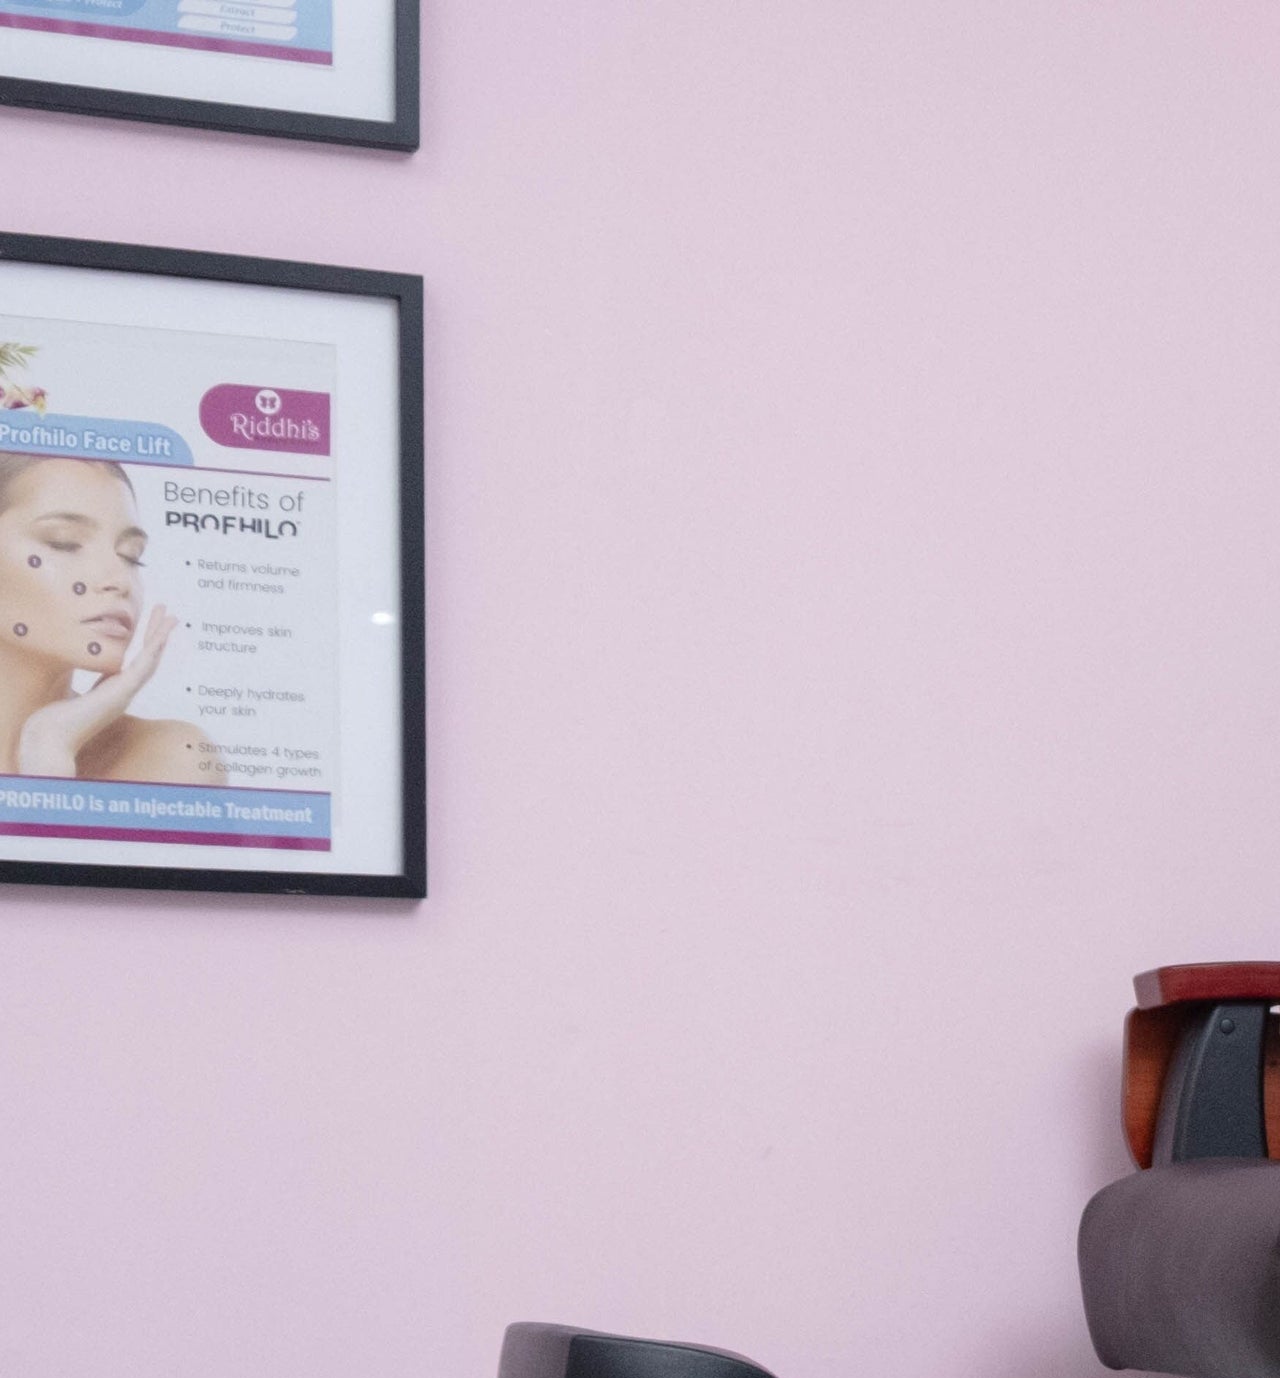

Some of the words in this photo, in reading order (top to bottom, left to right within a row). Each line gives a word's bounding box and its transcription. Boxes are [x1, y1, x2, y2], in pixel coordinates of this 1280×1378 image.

[230, 413, 320, 440] Riddhi's
[0, 424, 77, 448] Profhilo
[83, 431, 131, 453] Face
[137, 436, 171, 456] Lift
[164, 481, 269, 510] Benefits
[279, 491, 304, 512] of
[165, 511, 298, 539] PROFHILO
[197, 559, 247, 573] Returns
[251, 563, 300, 577] volume
[197, 578, 224, 589] and
[228, 579, 284, 594] firmness
[202, 622, 263, 636] Improves
[267, 626, 292, 638] skin
[198, 640, 257, 653] structure
[198, 685, 243, 700] Deeply
[247, 688, 305, 702] hydrates
[198, 704, 227, 716] your
[232, 705, 256, 717] skin
[198, 742, 267, 757] Stimulates
[271, 746, 279, 757] 4
[284, 747, 319, 760] types
[198, 760, 211, 771] of
[215, 761, 272, 777] collagen
[276, 766, 322, 779] growth
[89, 794, 104, 813] is
[108, 800, 130, 814] an
[134, 797, 221, 818] Injectable
[226, 802, 313, 823] Treatment
